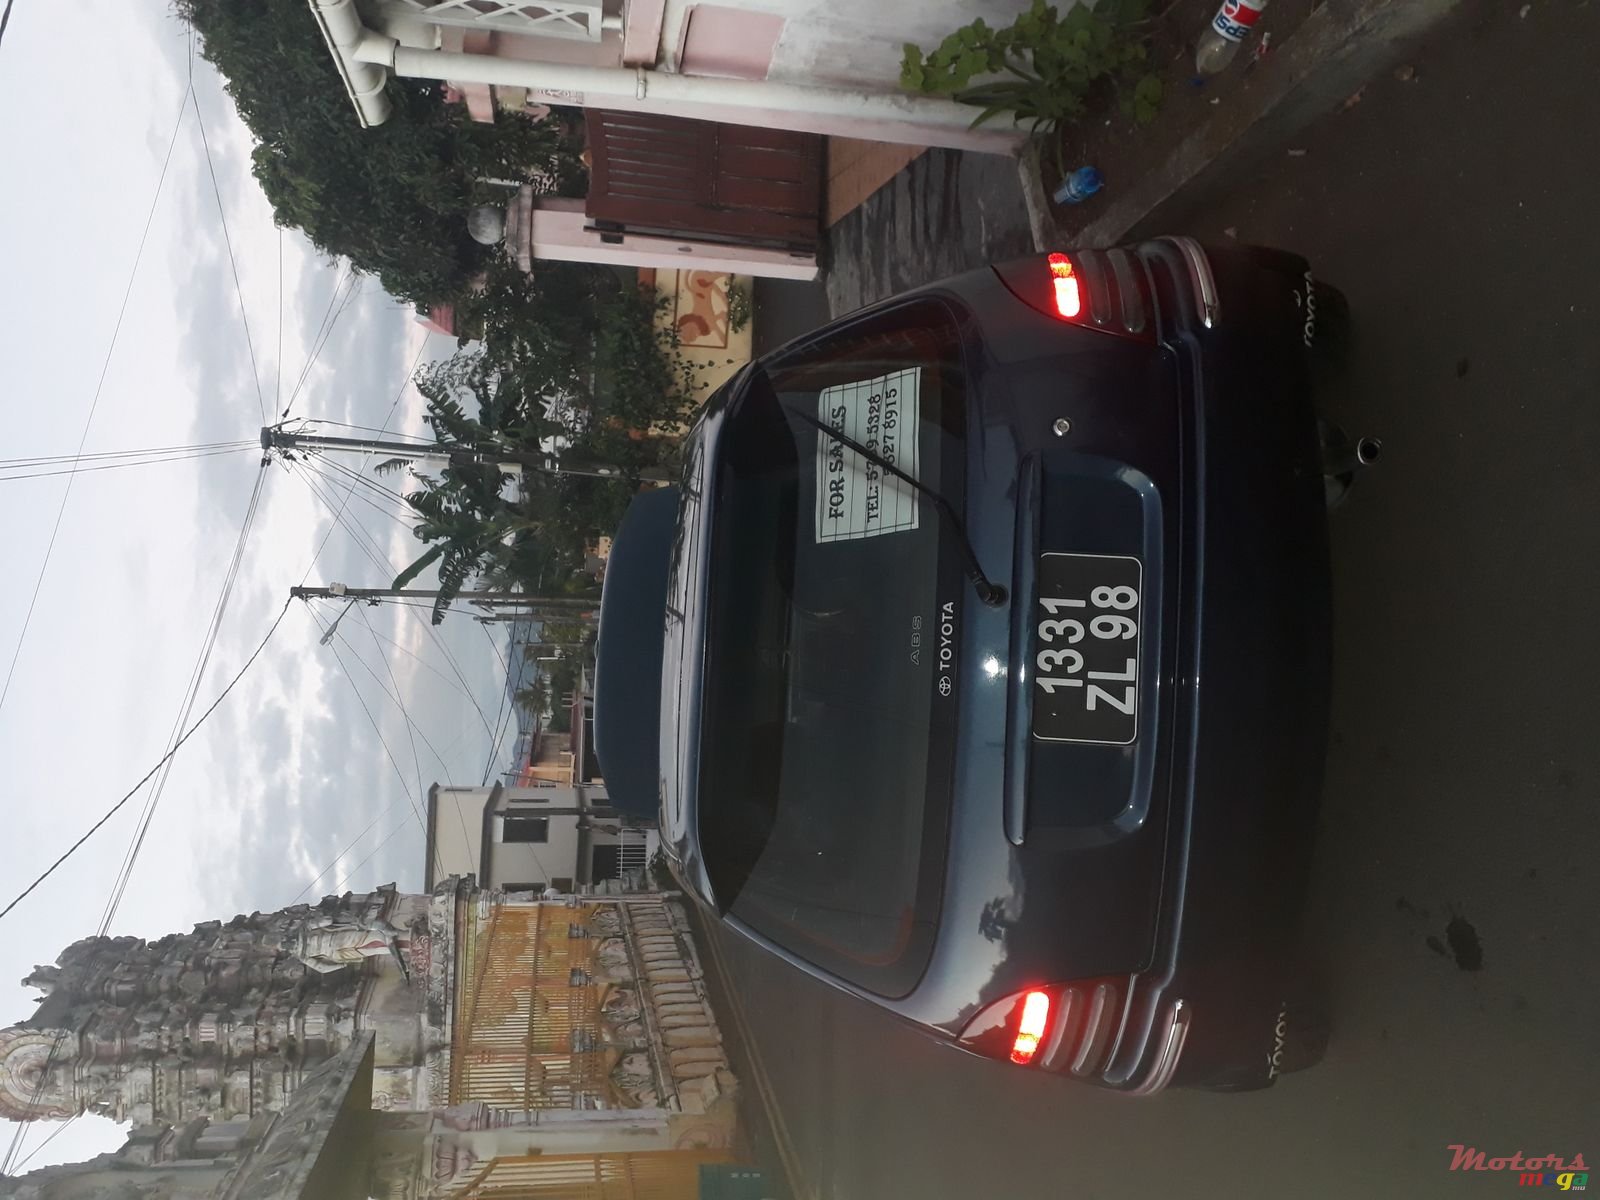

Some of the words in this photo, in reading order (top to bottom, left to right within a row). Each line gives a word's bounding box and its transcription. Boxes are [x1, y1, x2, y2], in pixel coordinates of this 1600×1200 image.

[866, 393, 881, 434] 5328
[882, 388, 898, 431] 8915
[866, 439, 879, 481] 579
[829, 477, 845, 519] FOR
[867, 486, 879, 523] TEL:
[939, 601, 954, 671] TOYOTA
[1089, 585, 1138, 640] 98
[910, 615, 922, 666] ABS
[1036, 597, 1086, 694] 1331
[1086, 658, 1136, 715] ZL
